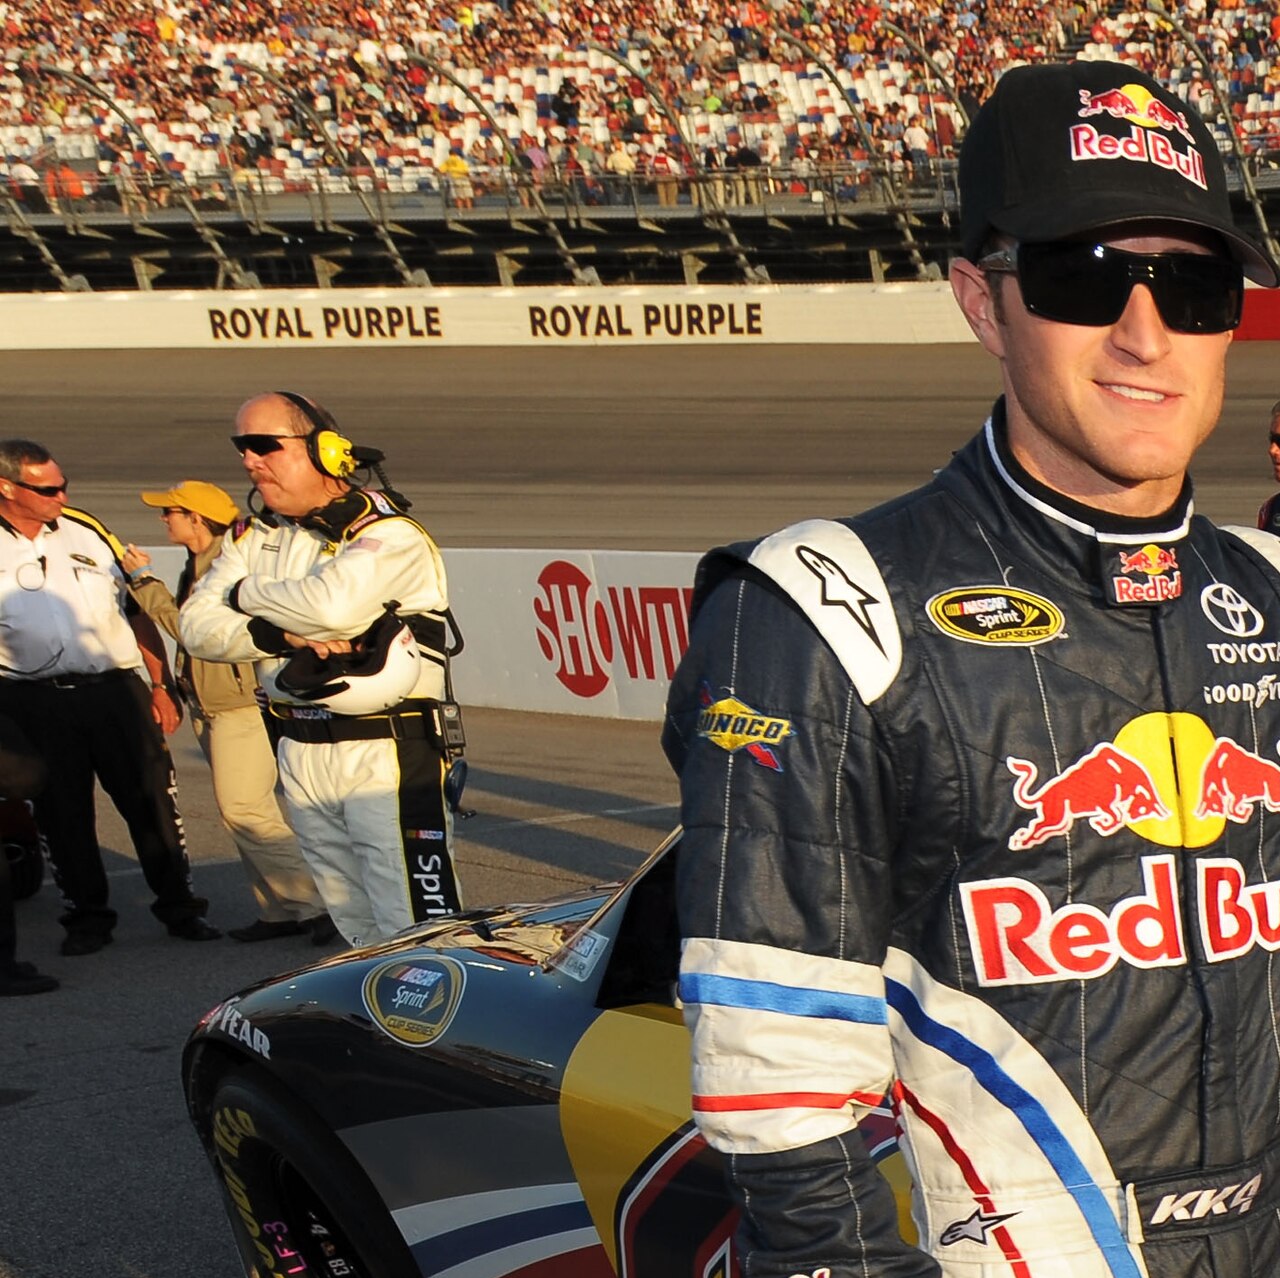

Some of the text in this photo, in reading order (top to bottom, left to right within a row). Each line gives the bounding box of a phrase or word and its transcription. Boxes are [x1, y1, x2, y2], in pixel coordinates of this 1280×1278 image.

[1069, 123, 1208, 190] Red Bull
[208, 306, 442, 340] ROYAL PURPLE
[528, 303, 762, 337] ROYAL PURPLE
[1113, 573, 1157, 603] Red
[962, 597, 1007, 615] NASCAR
[975, 609, 1022, 630] Sprint
[702, 710, 785, 739] UNOCO
[959, 854, 1188, 988] Red
[392, 985, 430, 1009] Sprint
[387, 1017, 436, 1037] CUP SERIES
[1150, 1172, 1263, 1225] KK4
[328, 1257, 350, 1277] 83
